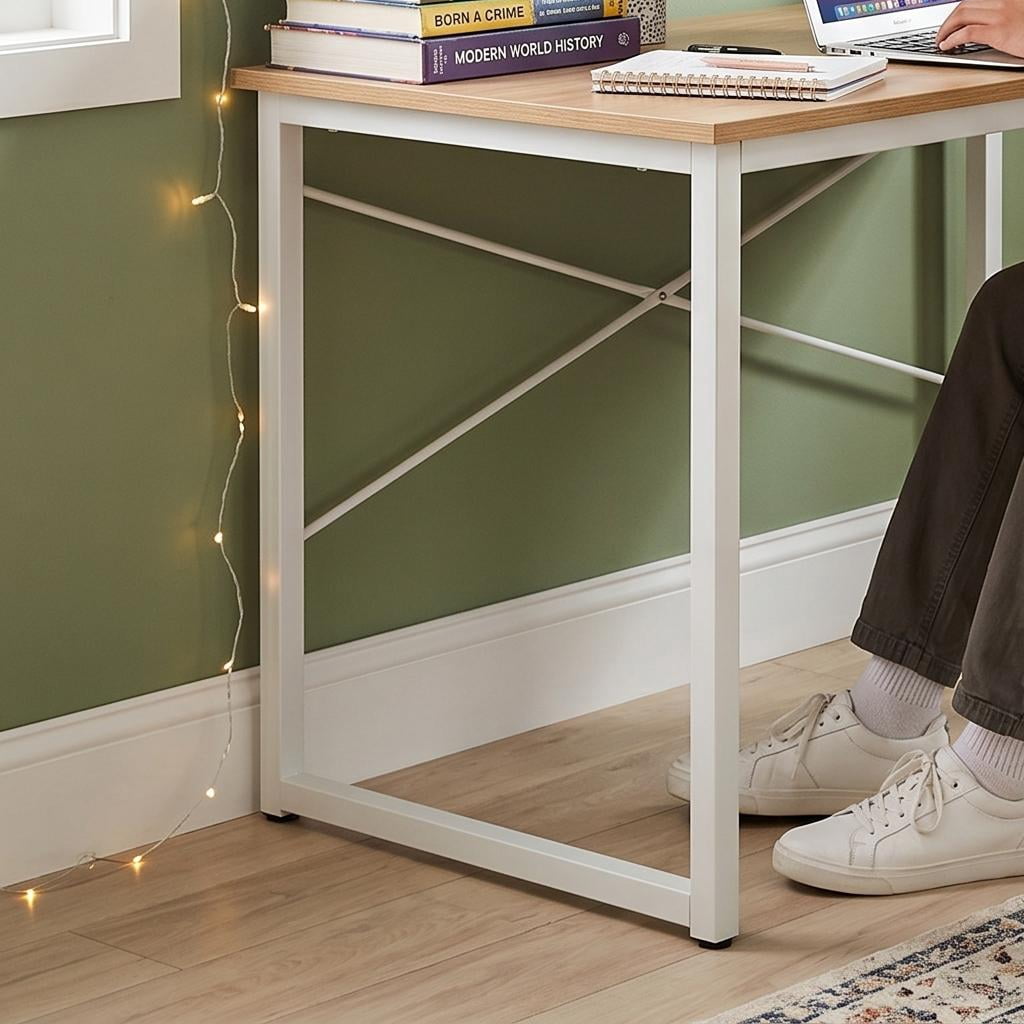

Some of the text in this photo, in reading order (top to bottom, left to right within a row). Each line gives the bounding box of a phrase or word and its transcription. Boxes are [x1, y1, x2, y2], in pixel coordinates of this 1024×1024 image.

[434, 6, 525, 27] BORN A CRIME
[455, 46, 507, 65] MODERN
[509, 40, 552, 59] WORLD
[555, 34, 604, 53] HISTORY
